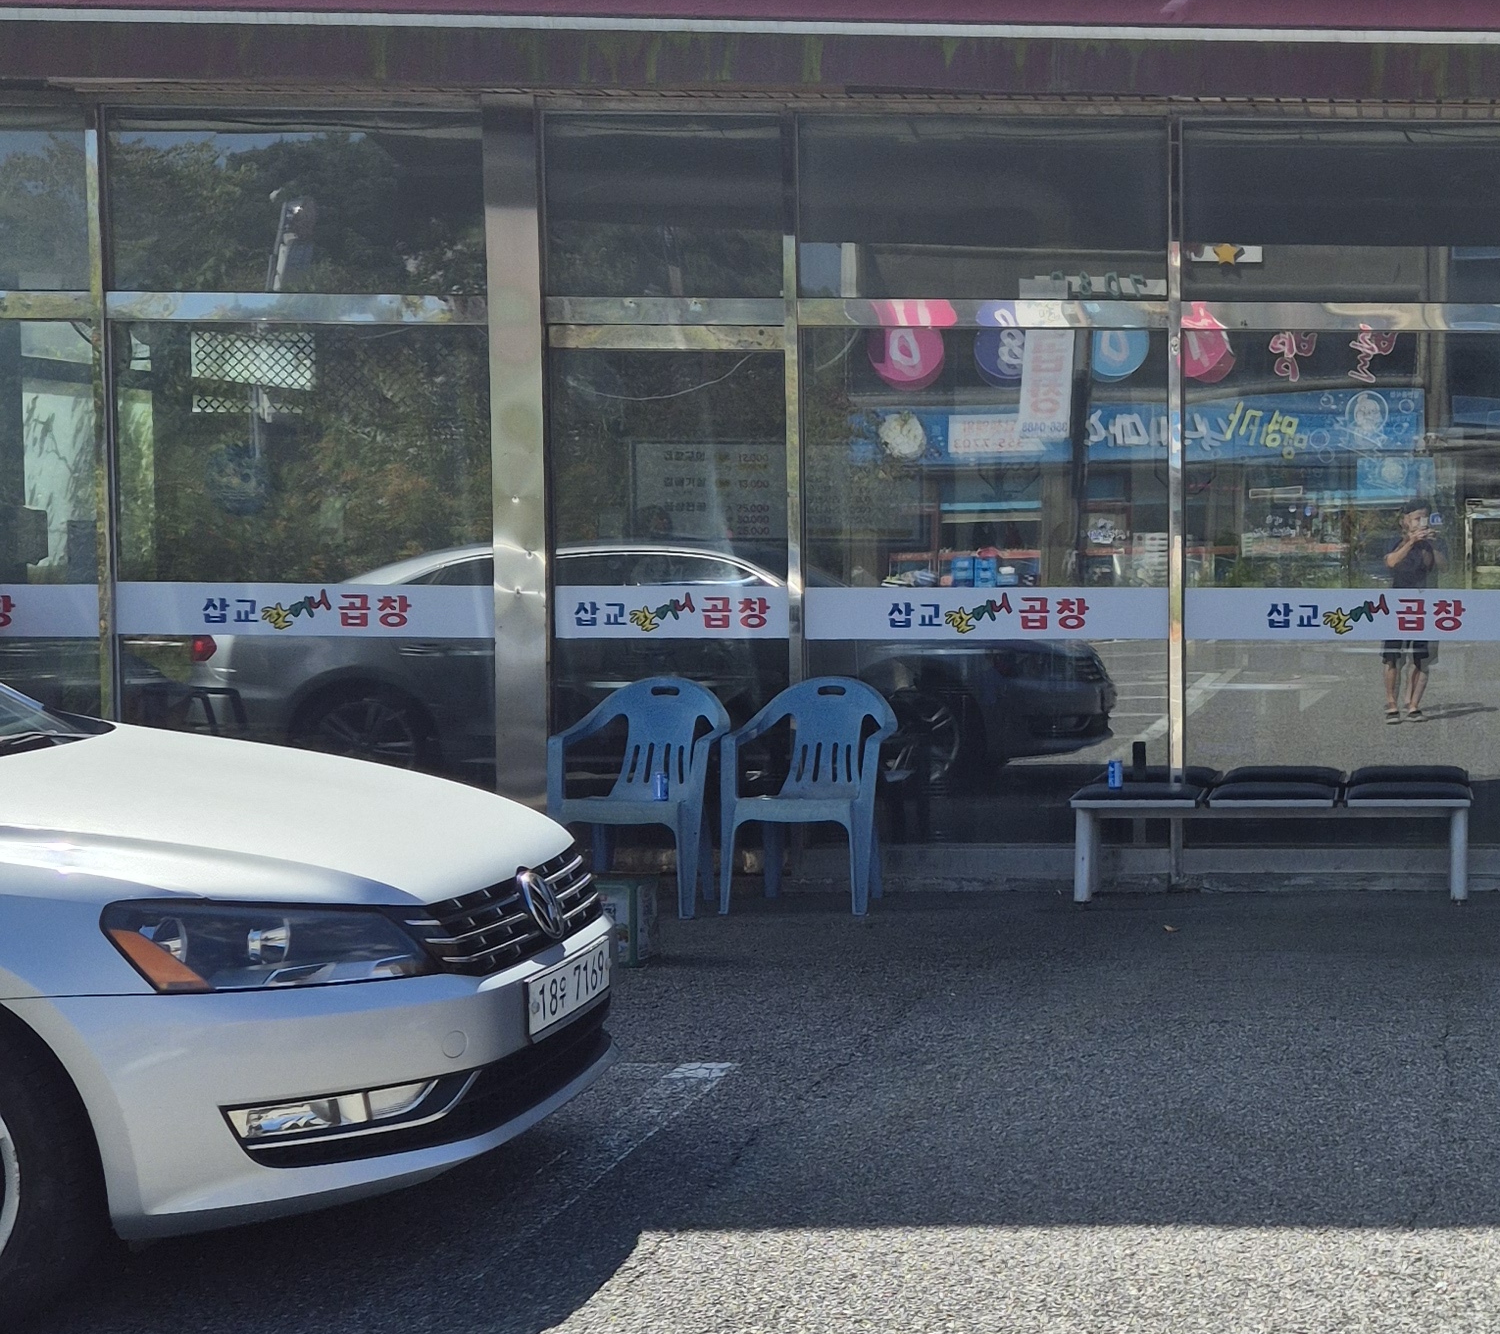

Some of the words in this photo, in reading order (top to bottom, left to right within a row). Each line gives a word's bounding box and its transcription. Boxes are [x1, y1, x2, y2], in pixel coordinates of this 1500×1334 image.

[202, 597, 259, 624] 삽교
[337, 594, 413, 628] 곱창
[574, 601, 628, 626] 삽교
[701, 596, 771, 629] 곱창
[887, 602, 943, 628] 삽교
[1018, 596, 1090, 630] 곱창
[1267, 602, 1321, 629] 삽교
[1396, 598, 1466, 632] 곱창
[539, 976, 567, 1021] 18우
[573, 949, 605, 1002] 7169
